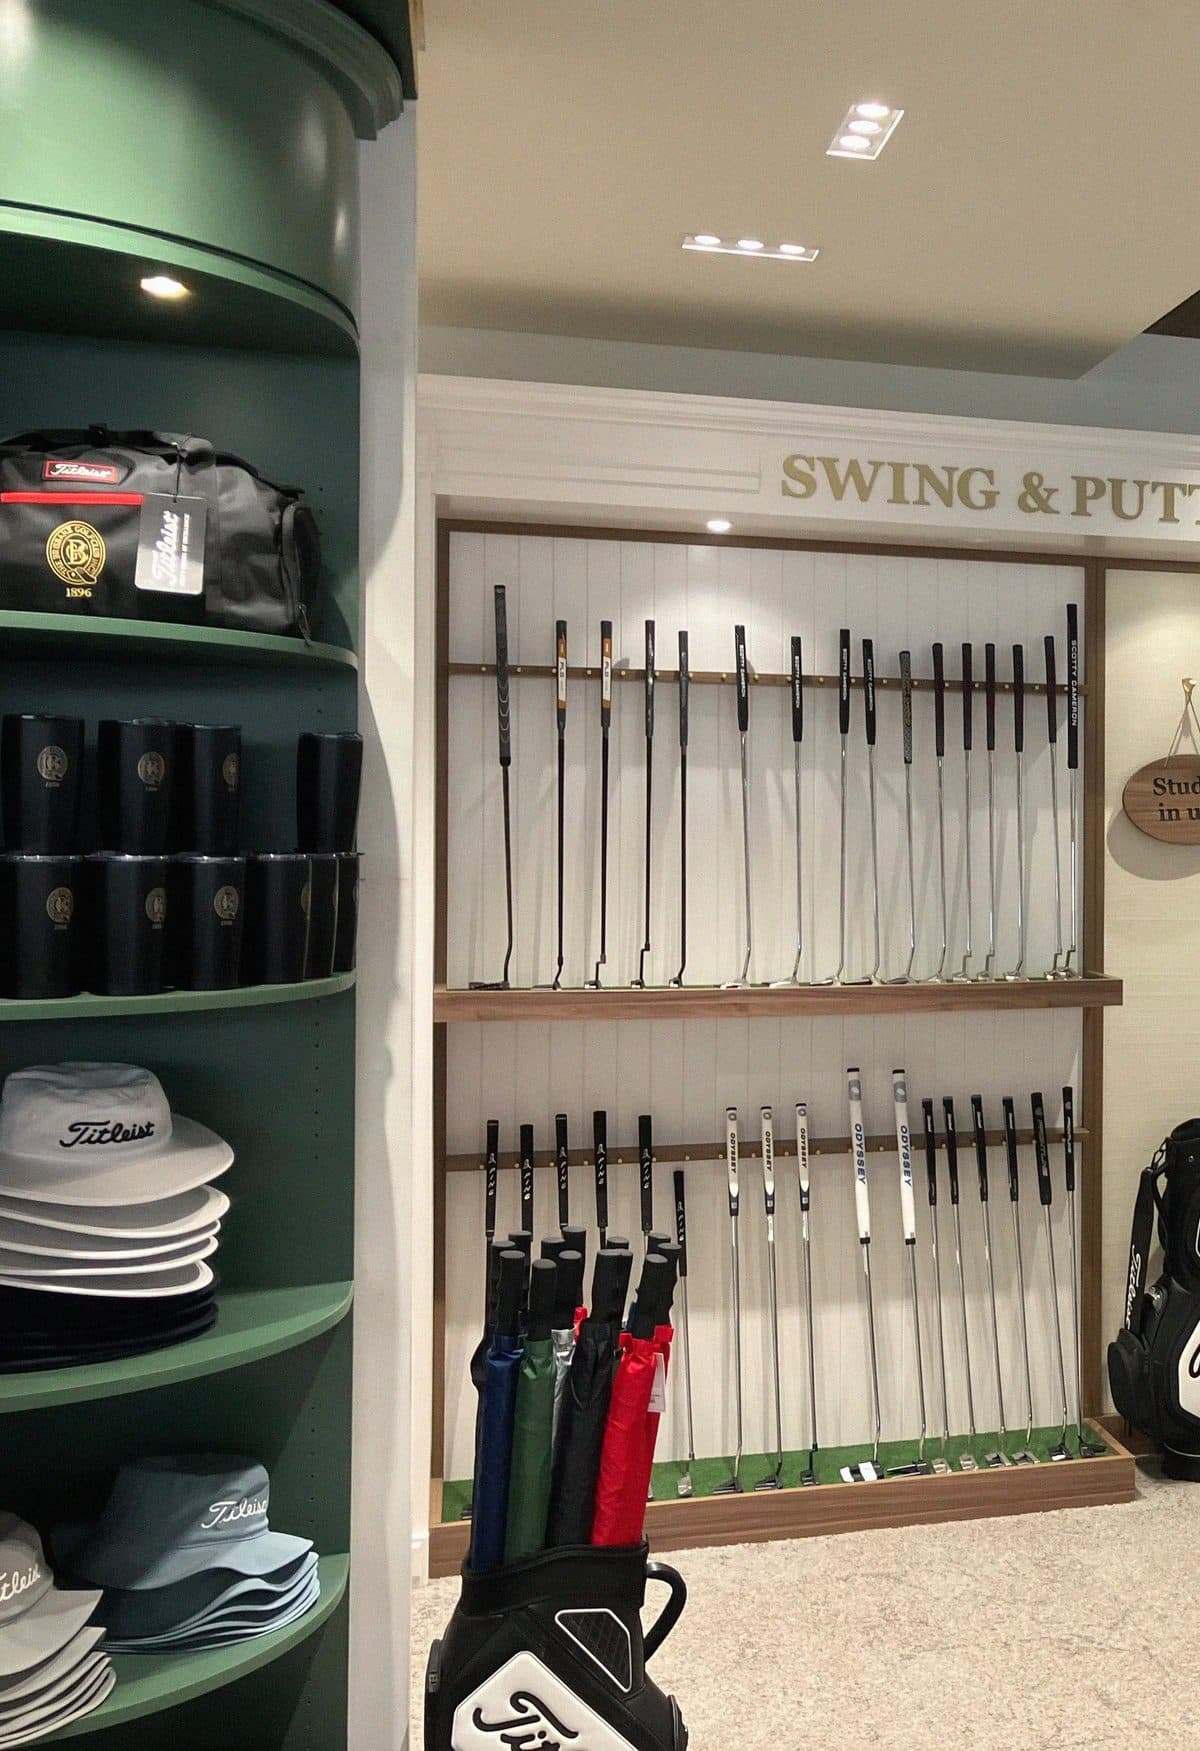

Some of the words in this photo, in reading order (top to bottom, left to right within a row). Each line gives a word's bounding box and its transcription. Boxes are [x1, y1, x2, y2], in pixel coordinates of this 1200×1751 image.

[780, 453, 1000, 511] SWING
[1017, 471, 1060, 515] &
[66, 588, 92, 598] 1896
[1158, 803, 1181, 822] in
[60, 1120, 154, 1148] Titleist
[854, 1122, 866, 1184] ODYSSEY
[900, 1124, 912, 1186] ODYSSEY
